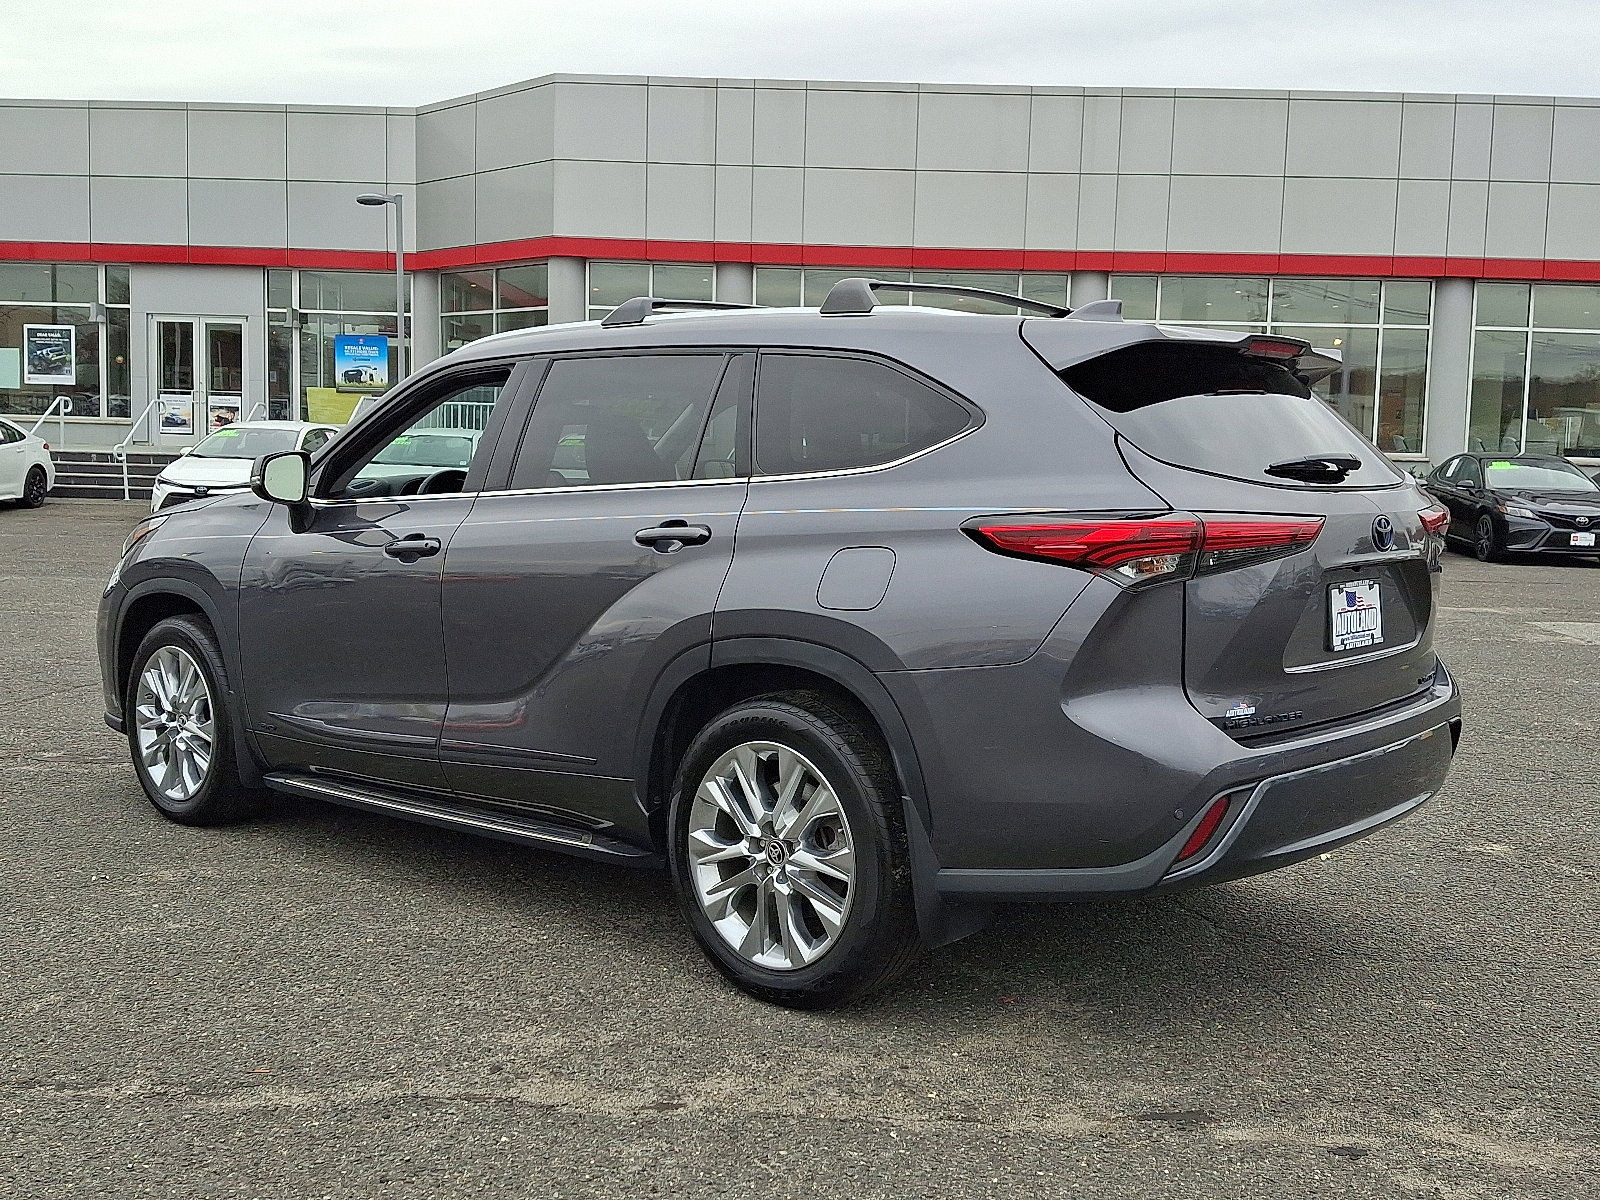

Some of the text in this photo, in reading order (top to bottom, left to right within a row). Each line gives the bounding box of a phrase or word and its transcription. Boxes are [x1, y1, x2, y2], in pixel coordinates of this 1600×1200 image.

[1336, 608, 1377, 637] AUTOLAND
[1224, 709, 1304, 730] HIGHLANDER
[1225, 706, 1256, 718] AUTOLAND
